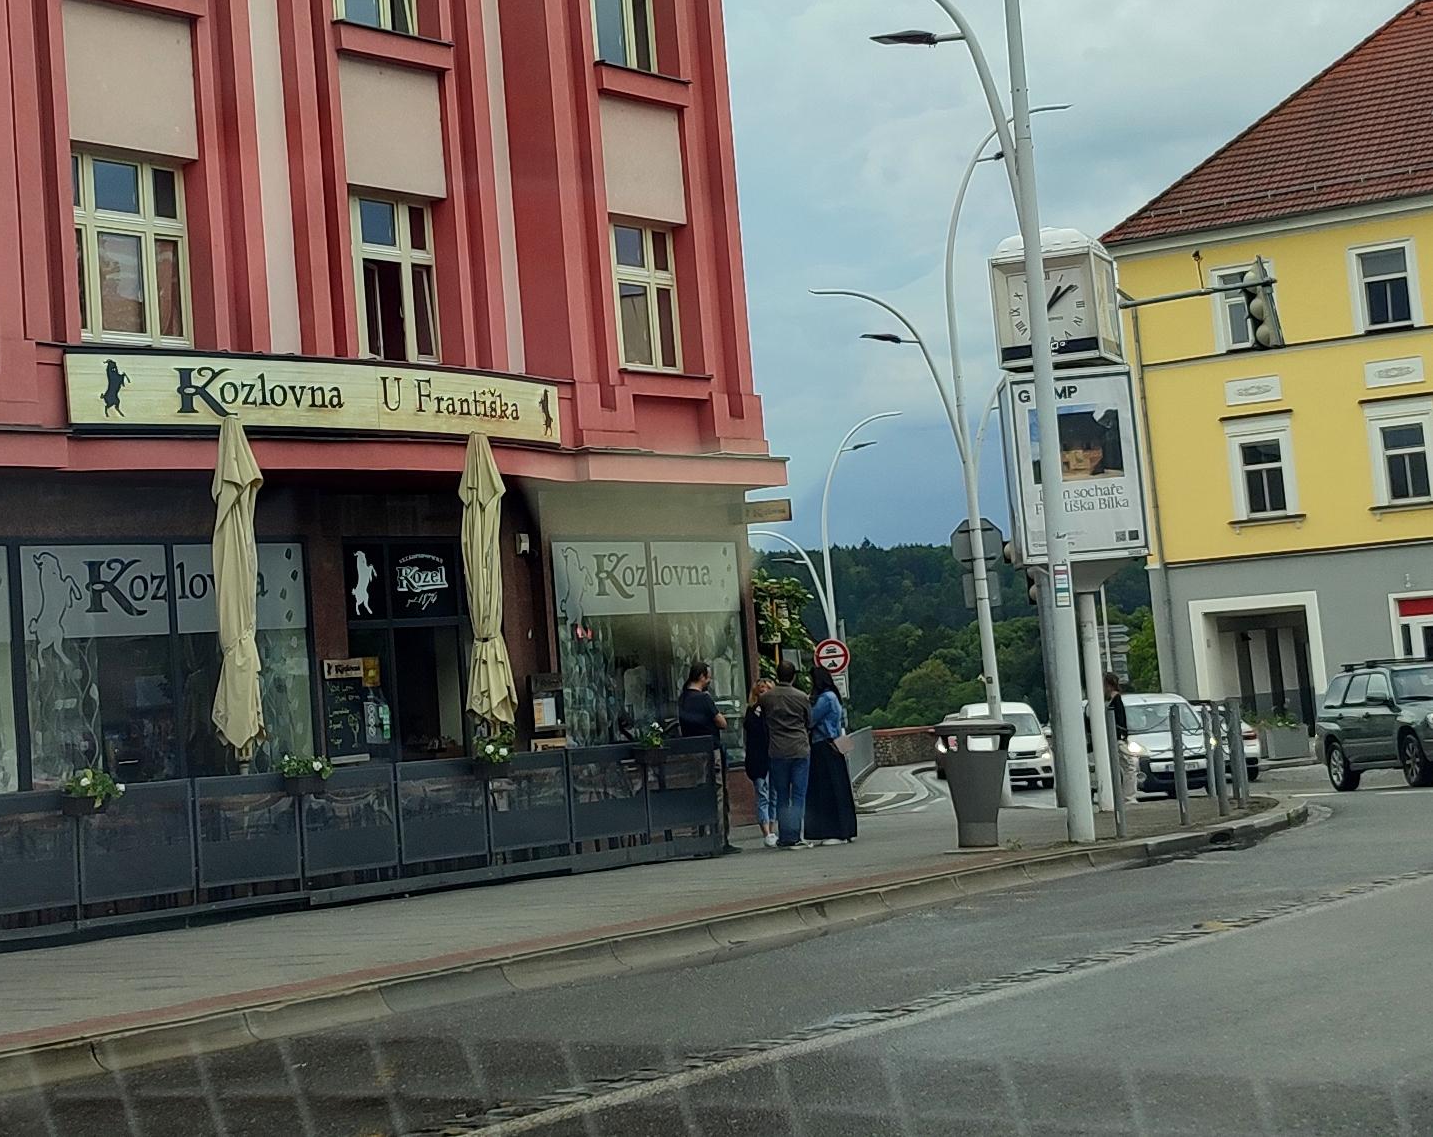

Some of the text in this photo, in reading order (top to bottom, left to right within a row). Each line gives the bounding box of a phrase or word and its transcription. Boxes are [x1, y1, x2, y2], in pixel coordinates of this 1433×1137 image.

[174, 366, 520, 422] Kozlovna U Františka
[1018, 385, 1078, 403] GMP
[1074, 484, 1124, 499] sochaře
[83, 558, 269, 616] Kozloa
[396, 566, 448, 592] Kozel
[592, 553, 712, 599] Kozlovna
